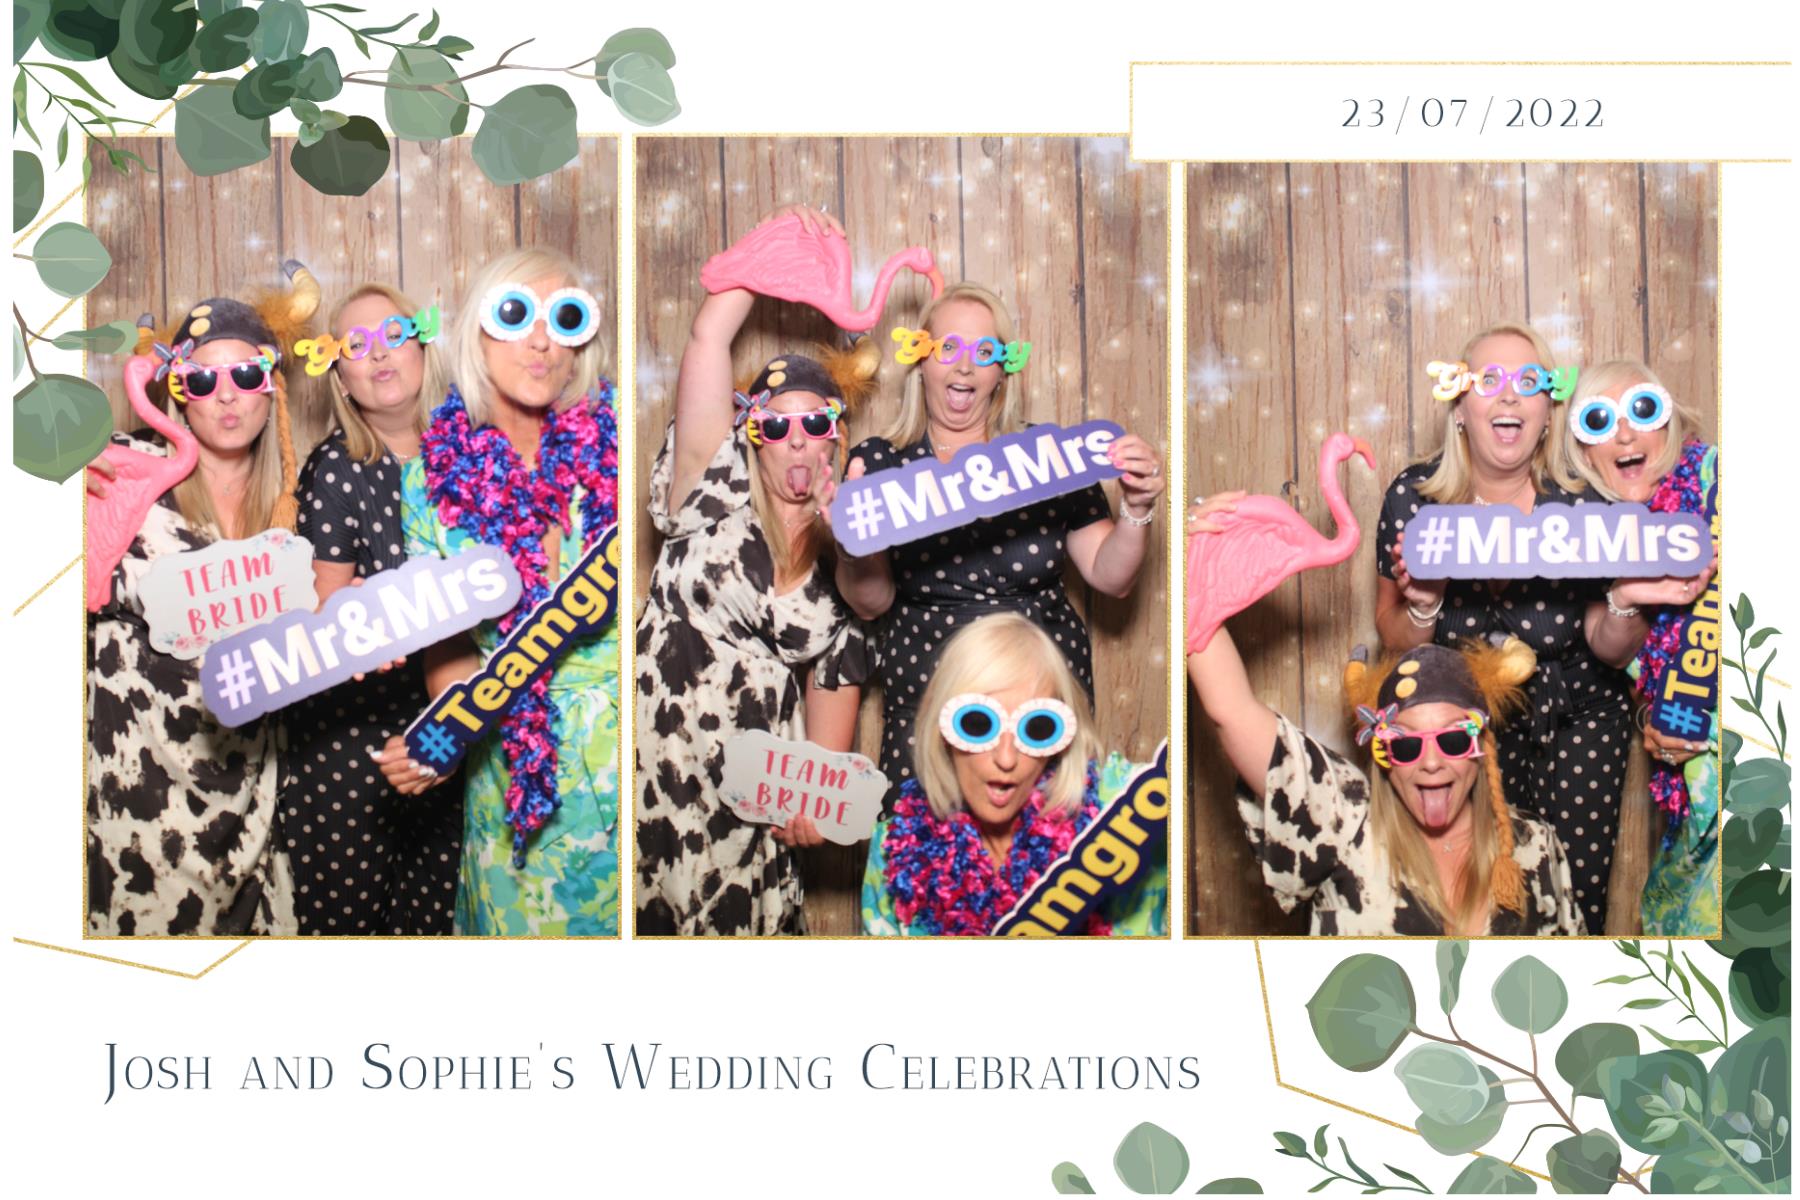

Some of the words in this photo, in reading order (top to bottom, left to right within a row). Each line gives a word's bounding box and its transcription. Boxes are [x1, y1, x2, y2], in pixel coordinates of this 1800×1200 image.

[845, 430, 1116, 541] #Mr&Mrs
[1416, 514, 1701, 565] #Mr&Mrs
[179, 552, 276, 597] TEAM
[187, 584, 290, 636] BRIDE
[215, 557, 508, 711] #Mr&Mrs
[763, 749, 849, 791] TEAM
[756, 782, 853, 826] BRIDE
